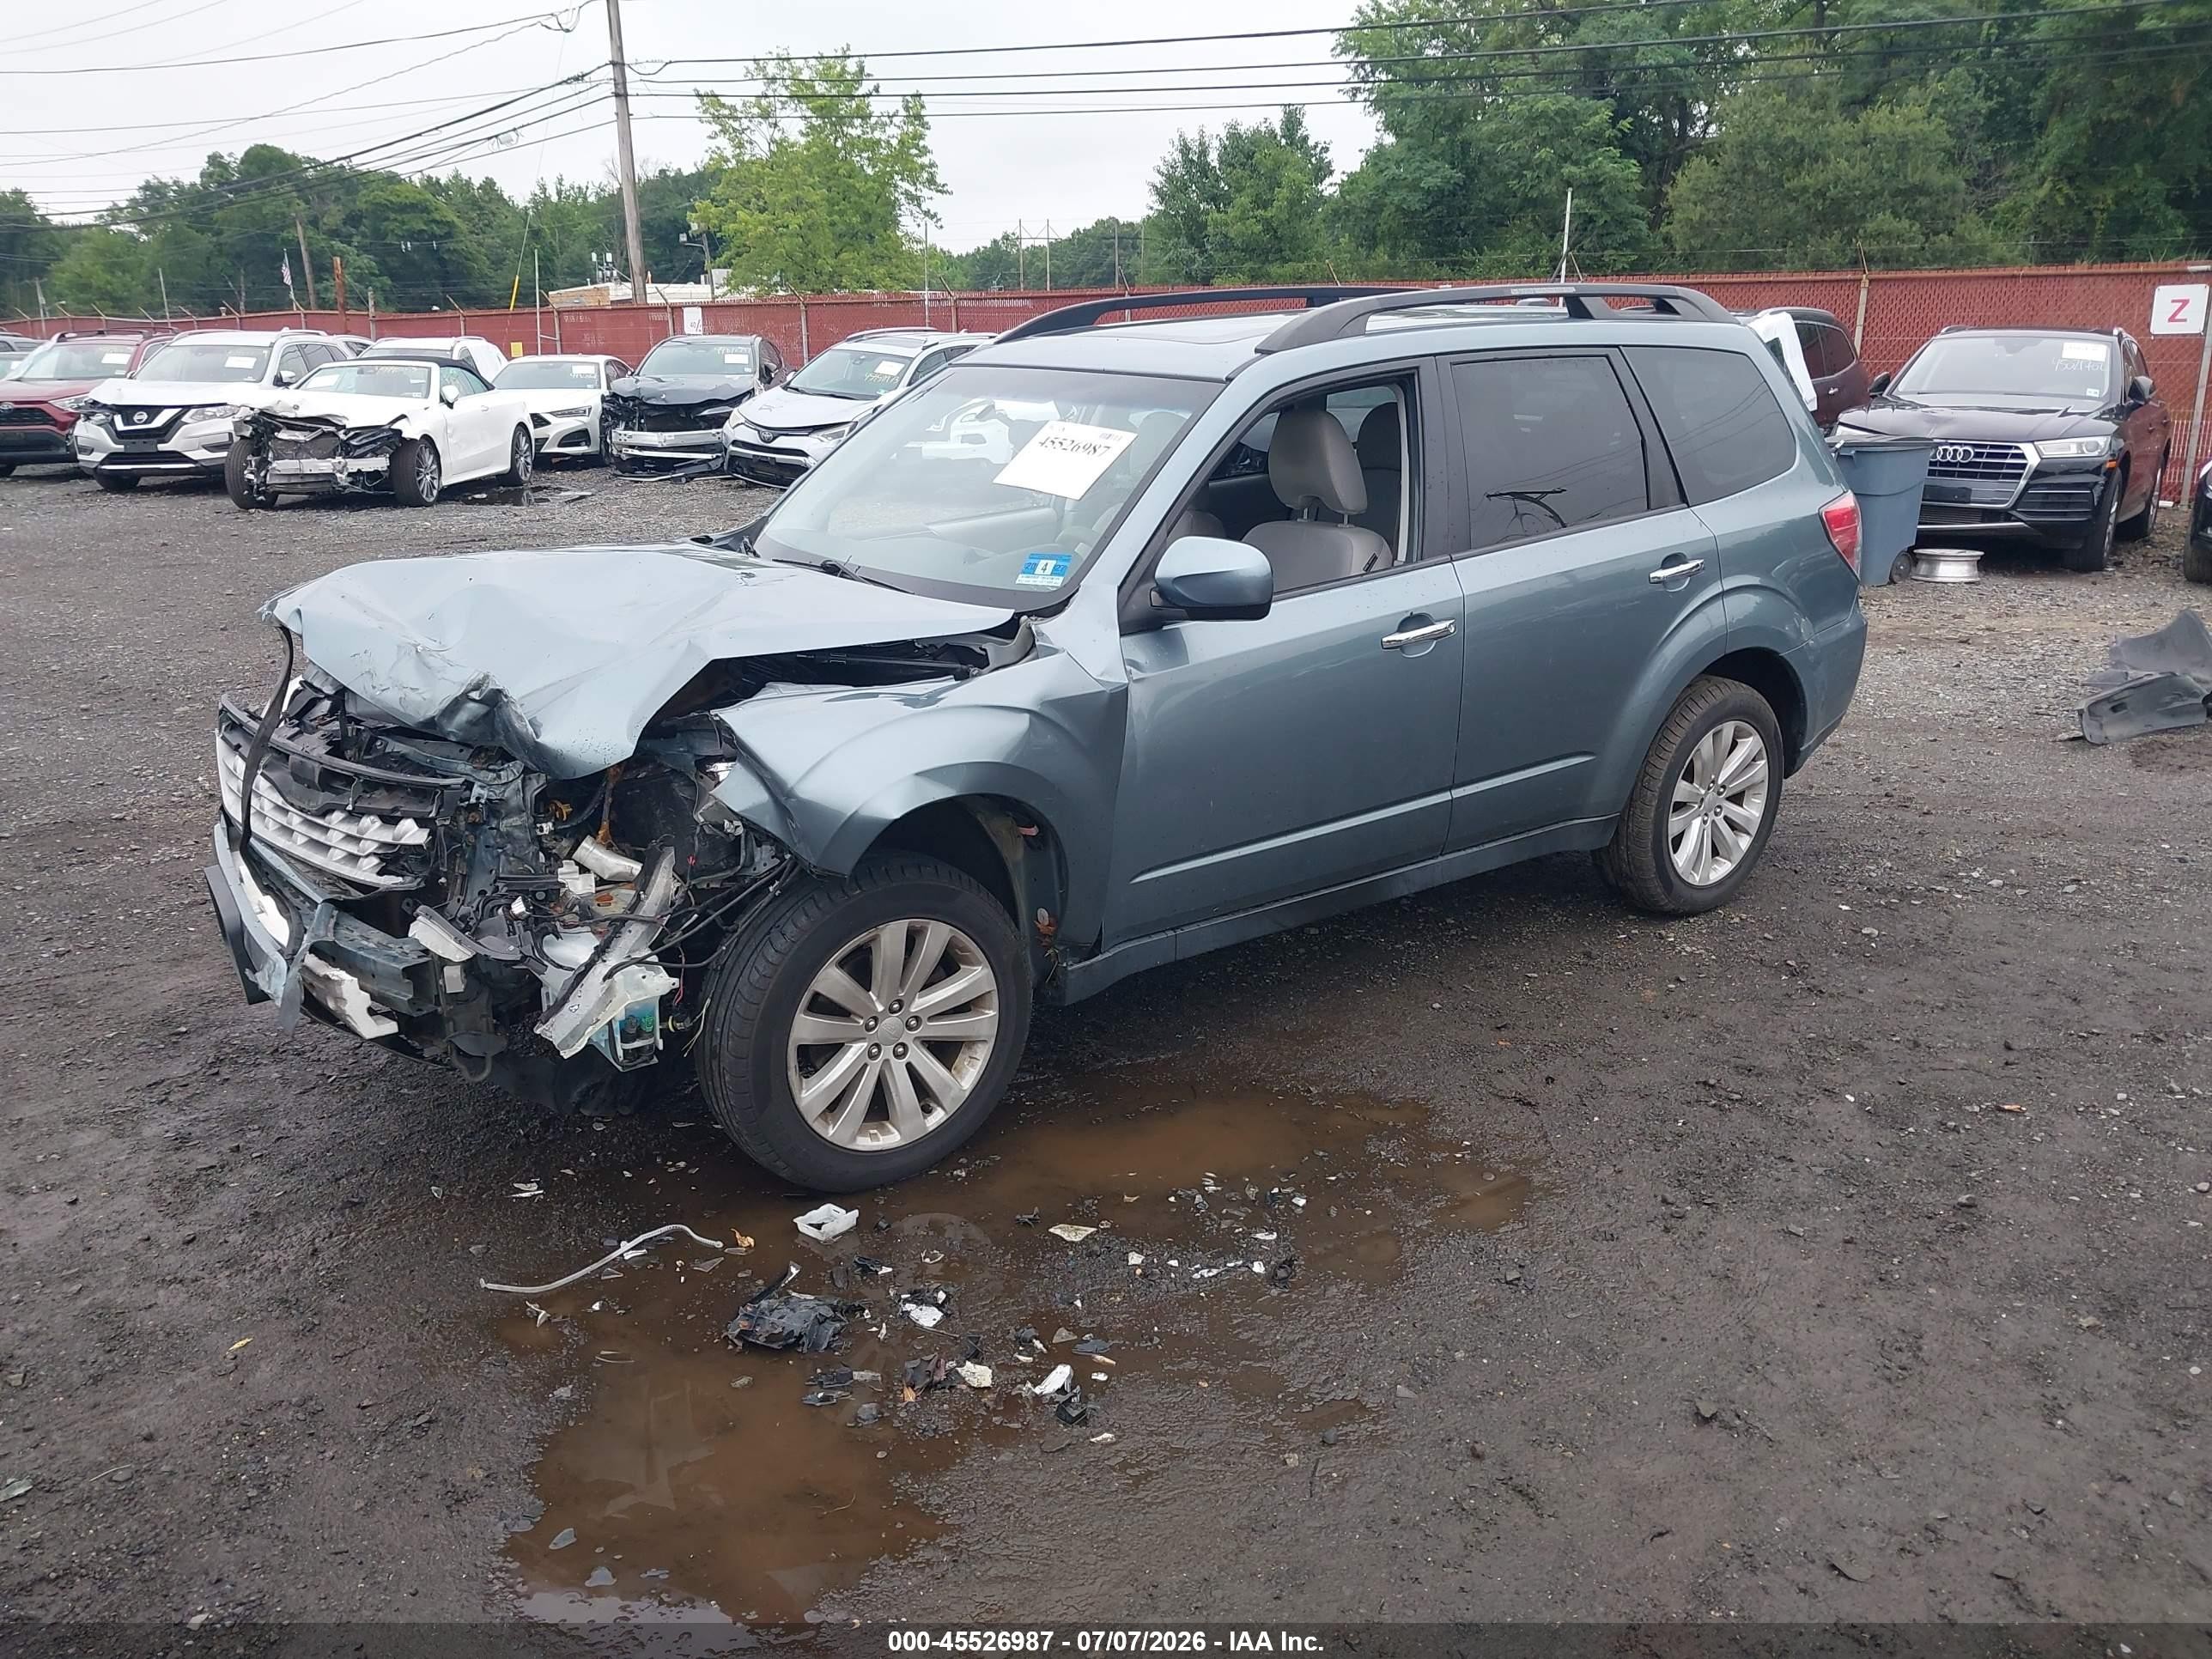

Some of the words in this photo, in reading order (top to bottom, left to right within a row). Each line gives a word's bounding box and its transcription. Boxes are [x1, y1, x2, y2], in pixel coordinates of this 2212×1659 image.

[2167, 298, 2190, 323] Z
[1038, 436, 1112, 458] 45526987
[1041, 562, 1048, 574] 4
